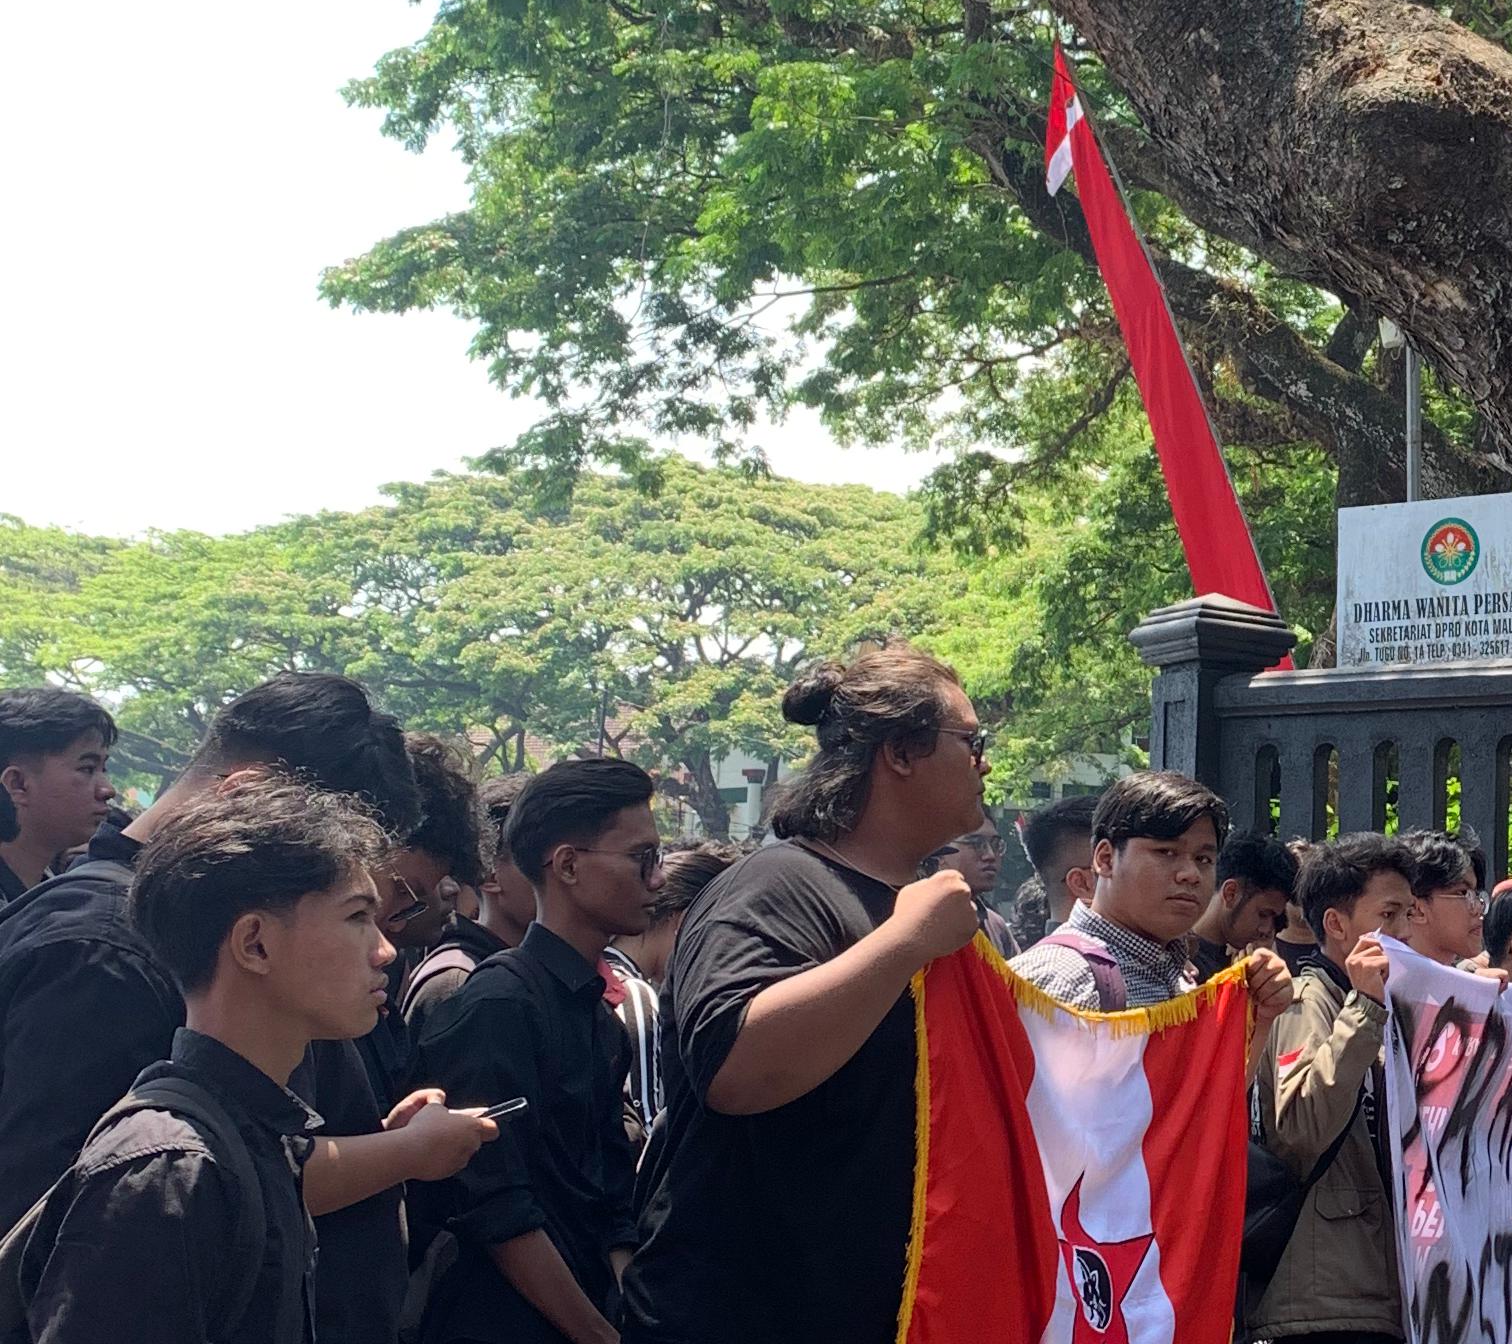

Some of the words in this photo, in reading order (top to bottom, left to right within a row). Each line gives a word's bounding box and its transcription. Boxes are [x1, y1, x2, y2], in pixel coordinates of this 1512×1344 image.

[1354, 599, 1411, 624] DHARMA
[1416, 594, 1469, 619] WANITA
[1369, 623, 1432, 644] SEKRETARIAT
[1435, 621, 1461, 639] DPRD
[1465, 619, 1490, 637] KOTA
[1374, 645, 1396, 662] TUGU
